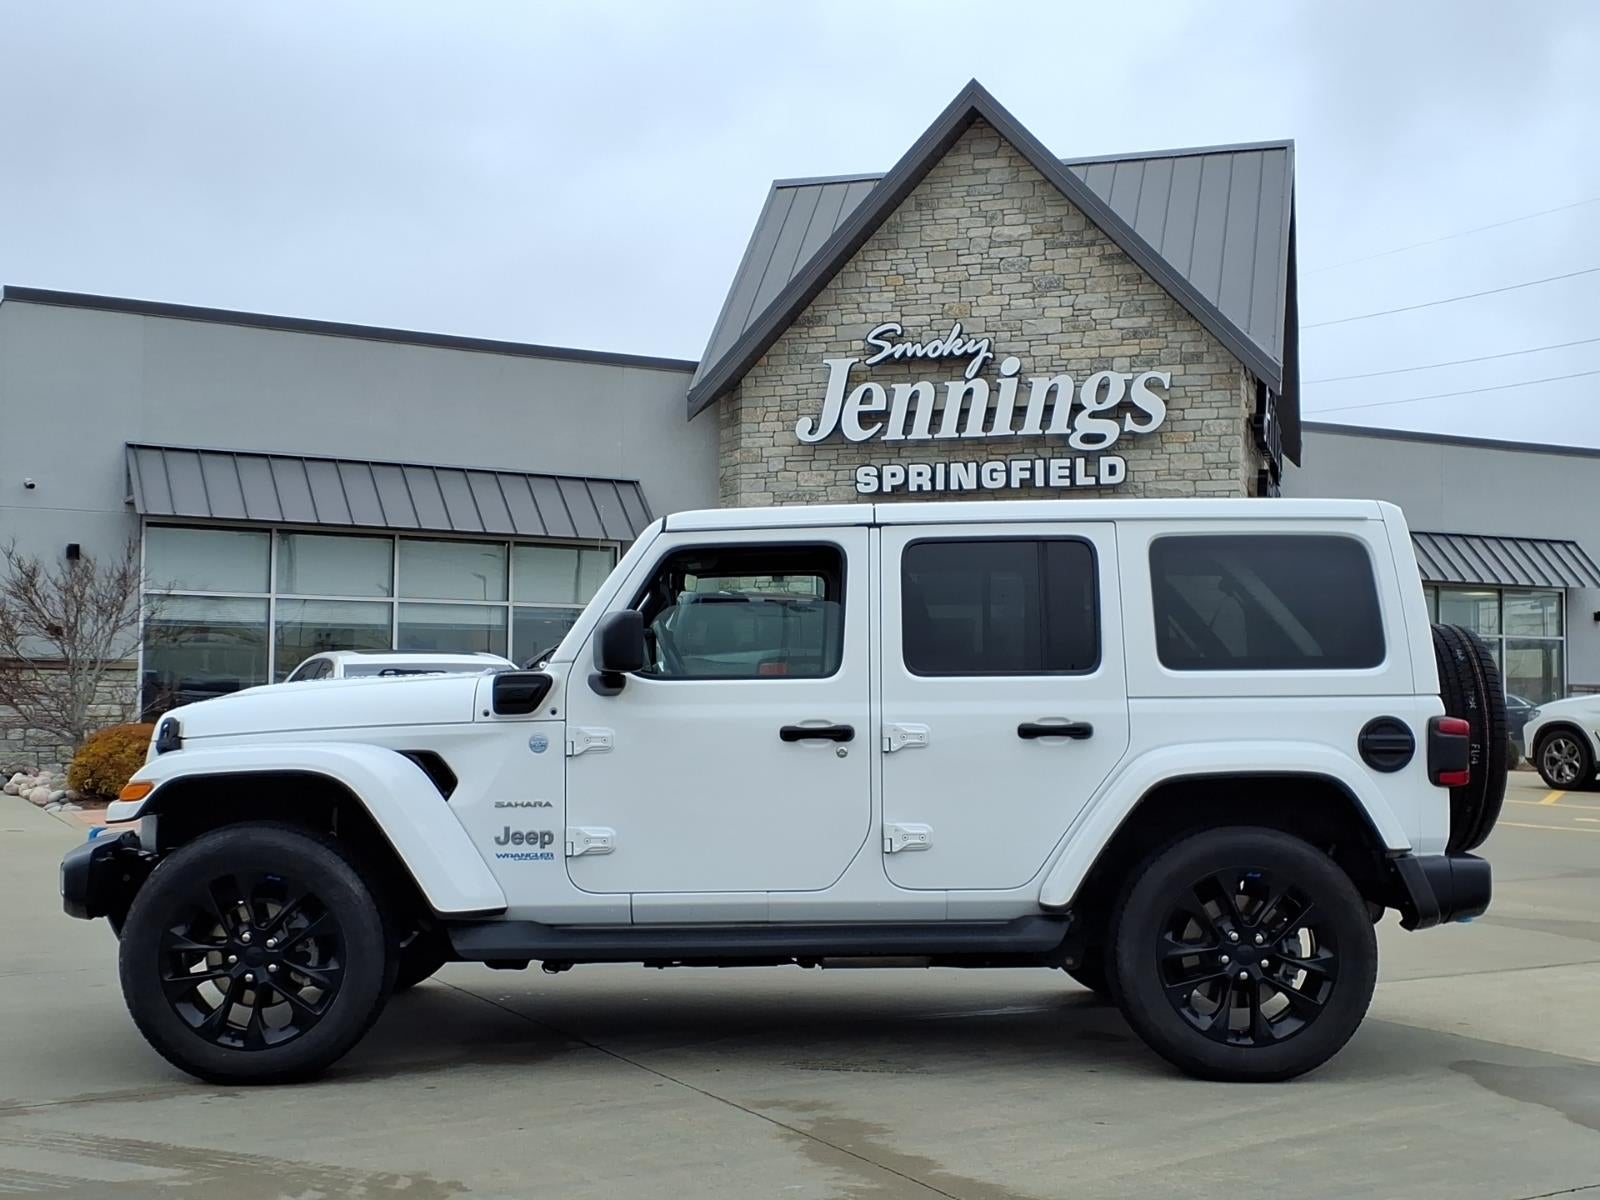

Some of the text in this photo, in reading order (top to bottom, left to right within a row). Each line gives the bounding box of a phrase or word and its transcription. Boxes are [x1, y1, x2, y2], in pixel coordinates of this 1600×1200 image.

[865, 323, 993, 377] Smoky
[796, 356, 1171, 451] Jennings
[855, 455, 1127, 494] SPRINGFIELD
[494, 826, 554, 849] Jeep
